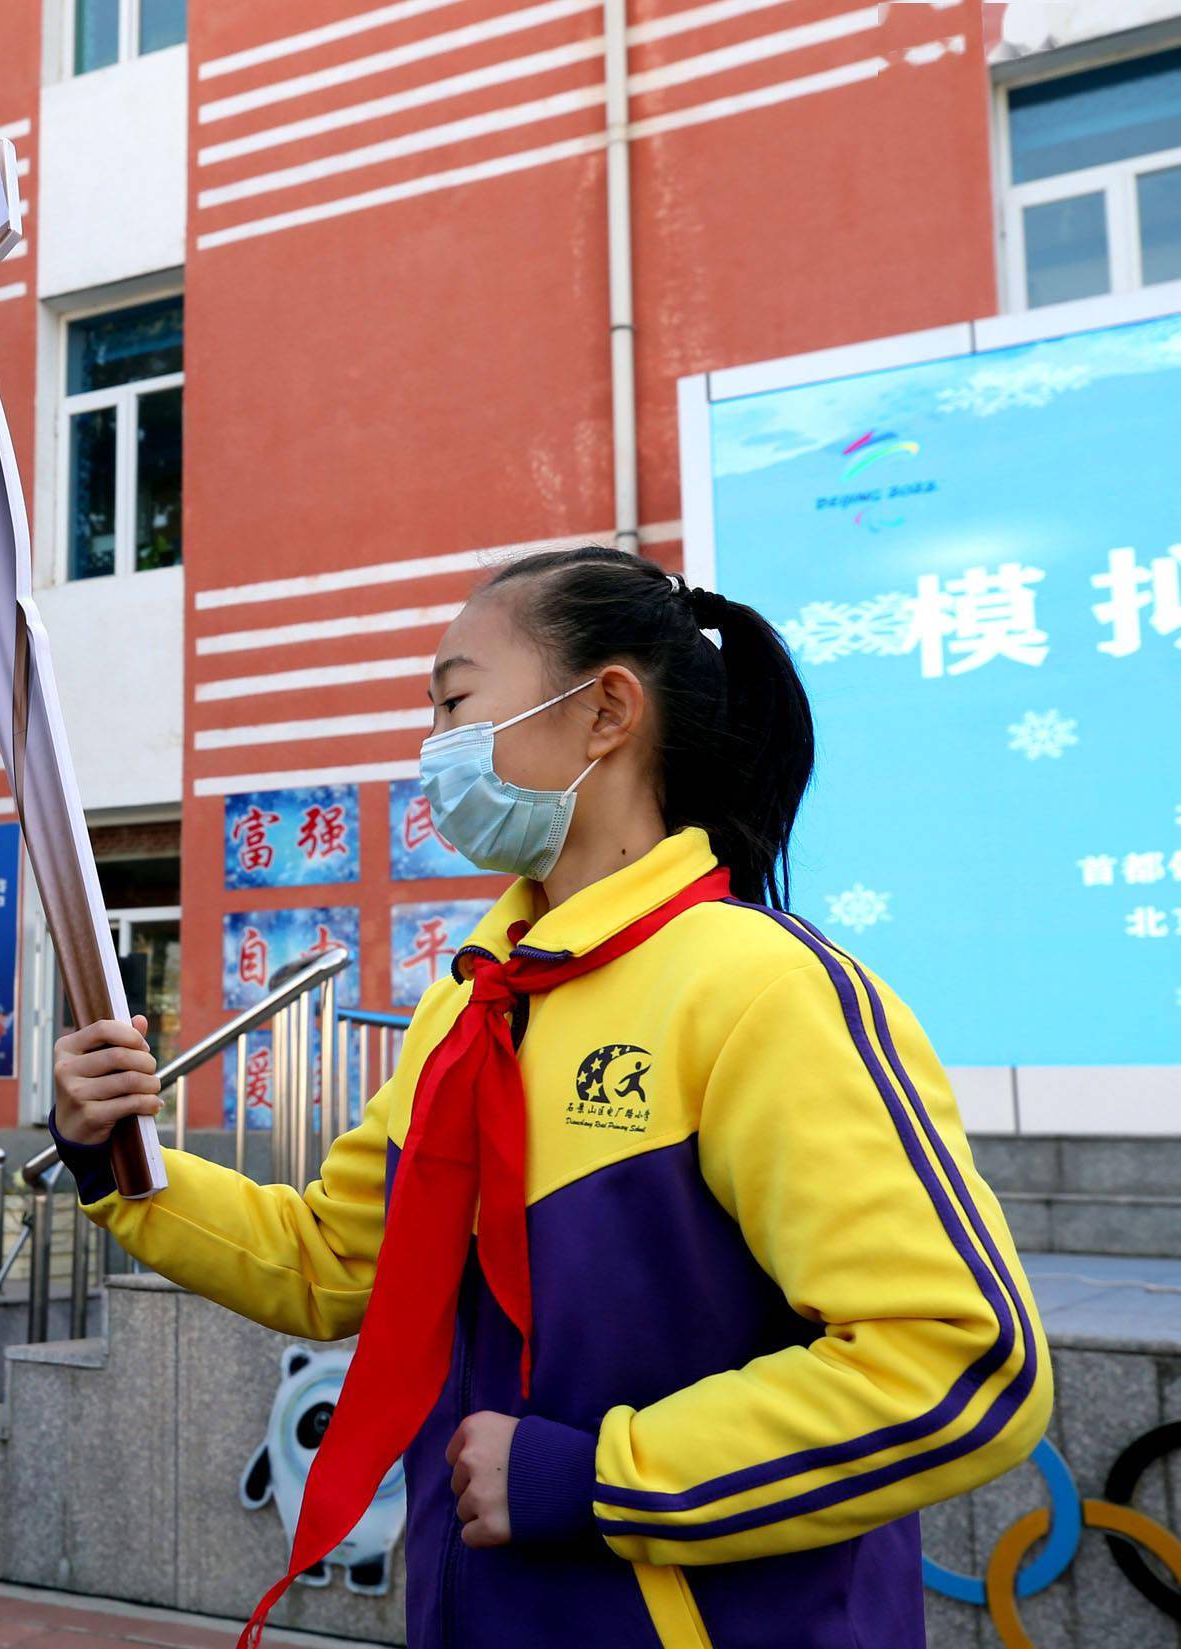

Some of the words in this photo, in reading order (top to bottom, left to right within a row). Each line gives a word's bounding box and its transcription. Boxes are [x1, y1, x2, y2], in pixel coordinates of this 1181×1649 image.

[232, 806, 347, 871] 富强
[403, 919, 456, 983] 平
[1125, 905, 1181, 938] 北
